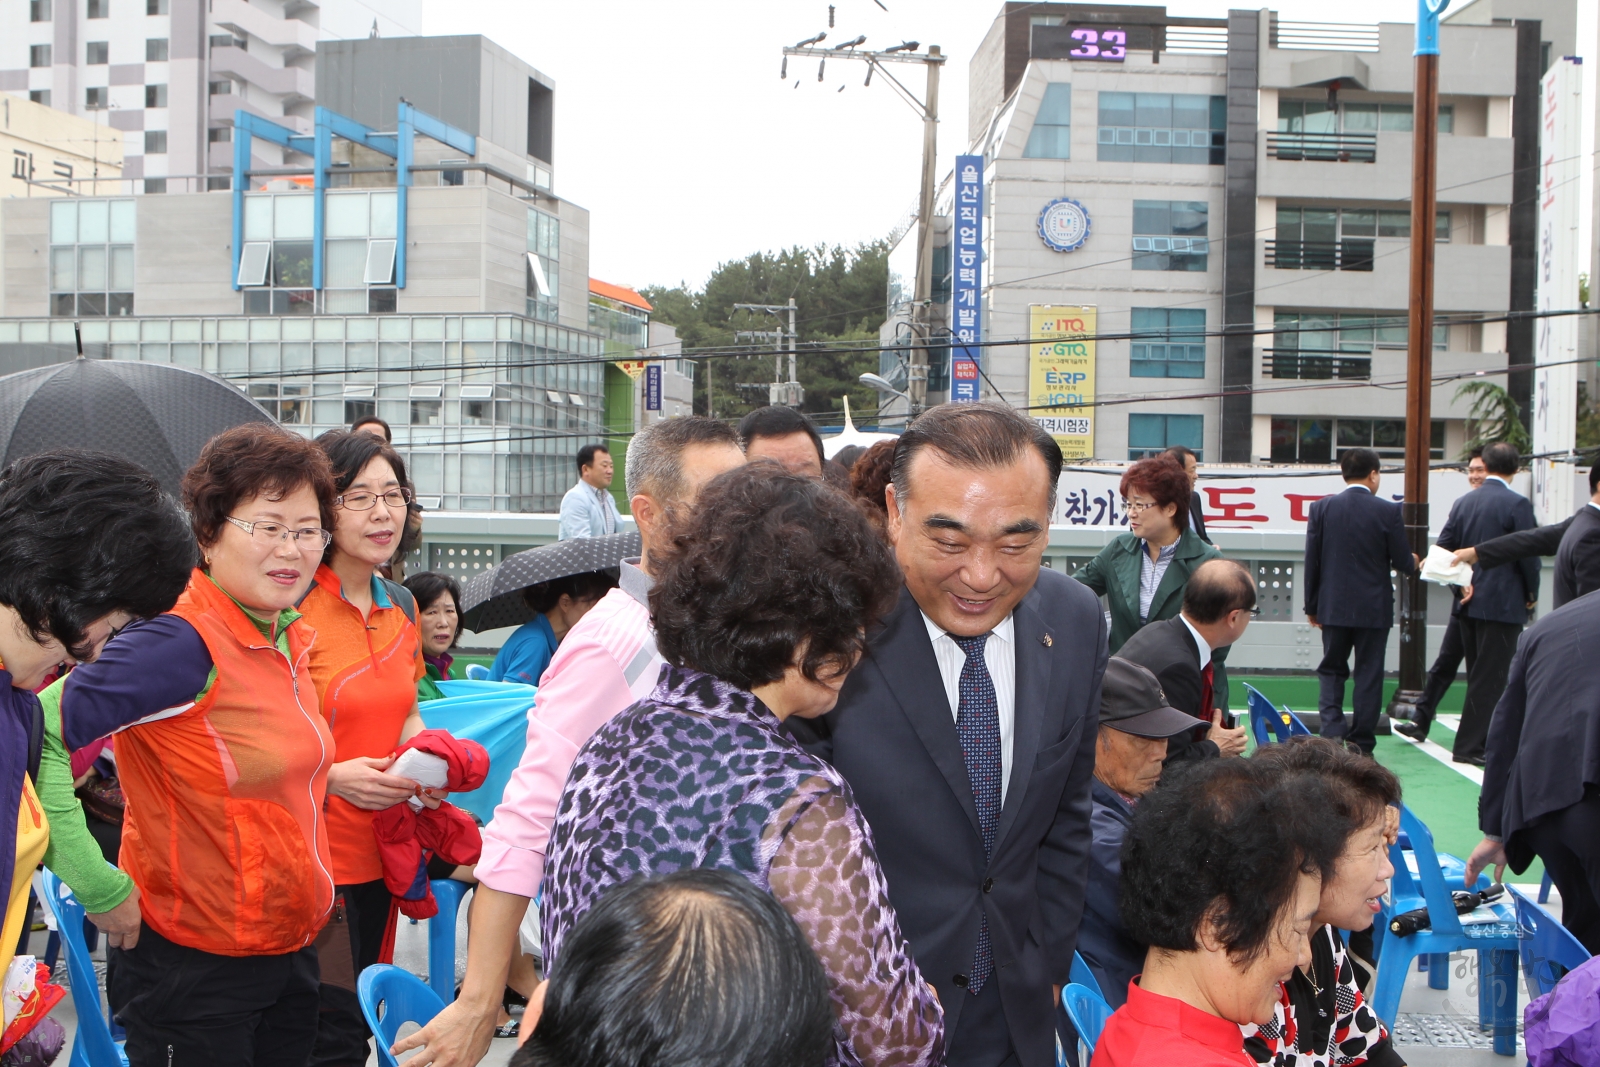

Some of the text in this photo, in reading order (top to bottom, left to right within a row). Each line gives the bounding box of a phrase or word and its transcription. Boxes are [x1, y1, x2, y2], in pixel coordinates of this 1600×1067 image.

[1070, 29, 1126, 59] 33
[958, 165, 979, 343] 울산직업능력개발원
[1056, 318, 1086, 332] ITQ
[1053, 343, 1088, 356] GTQ
[1045, 371, 1087, 385] ERP
